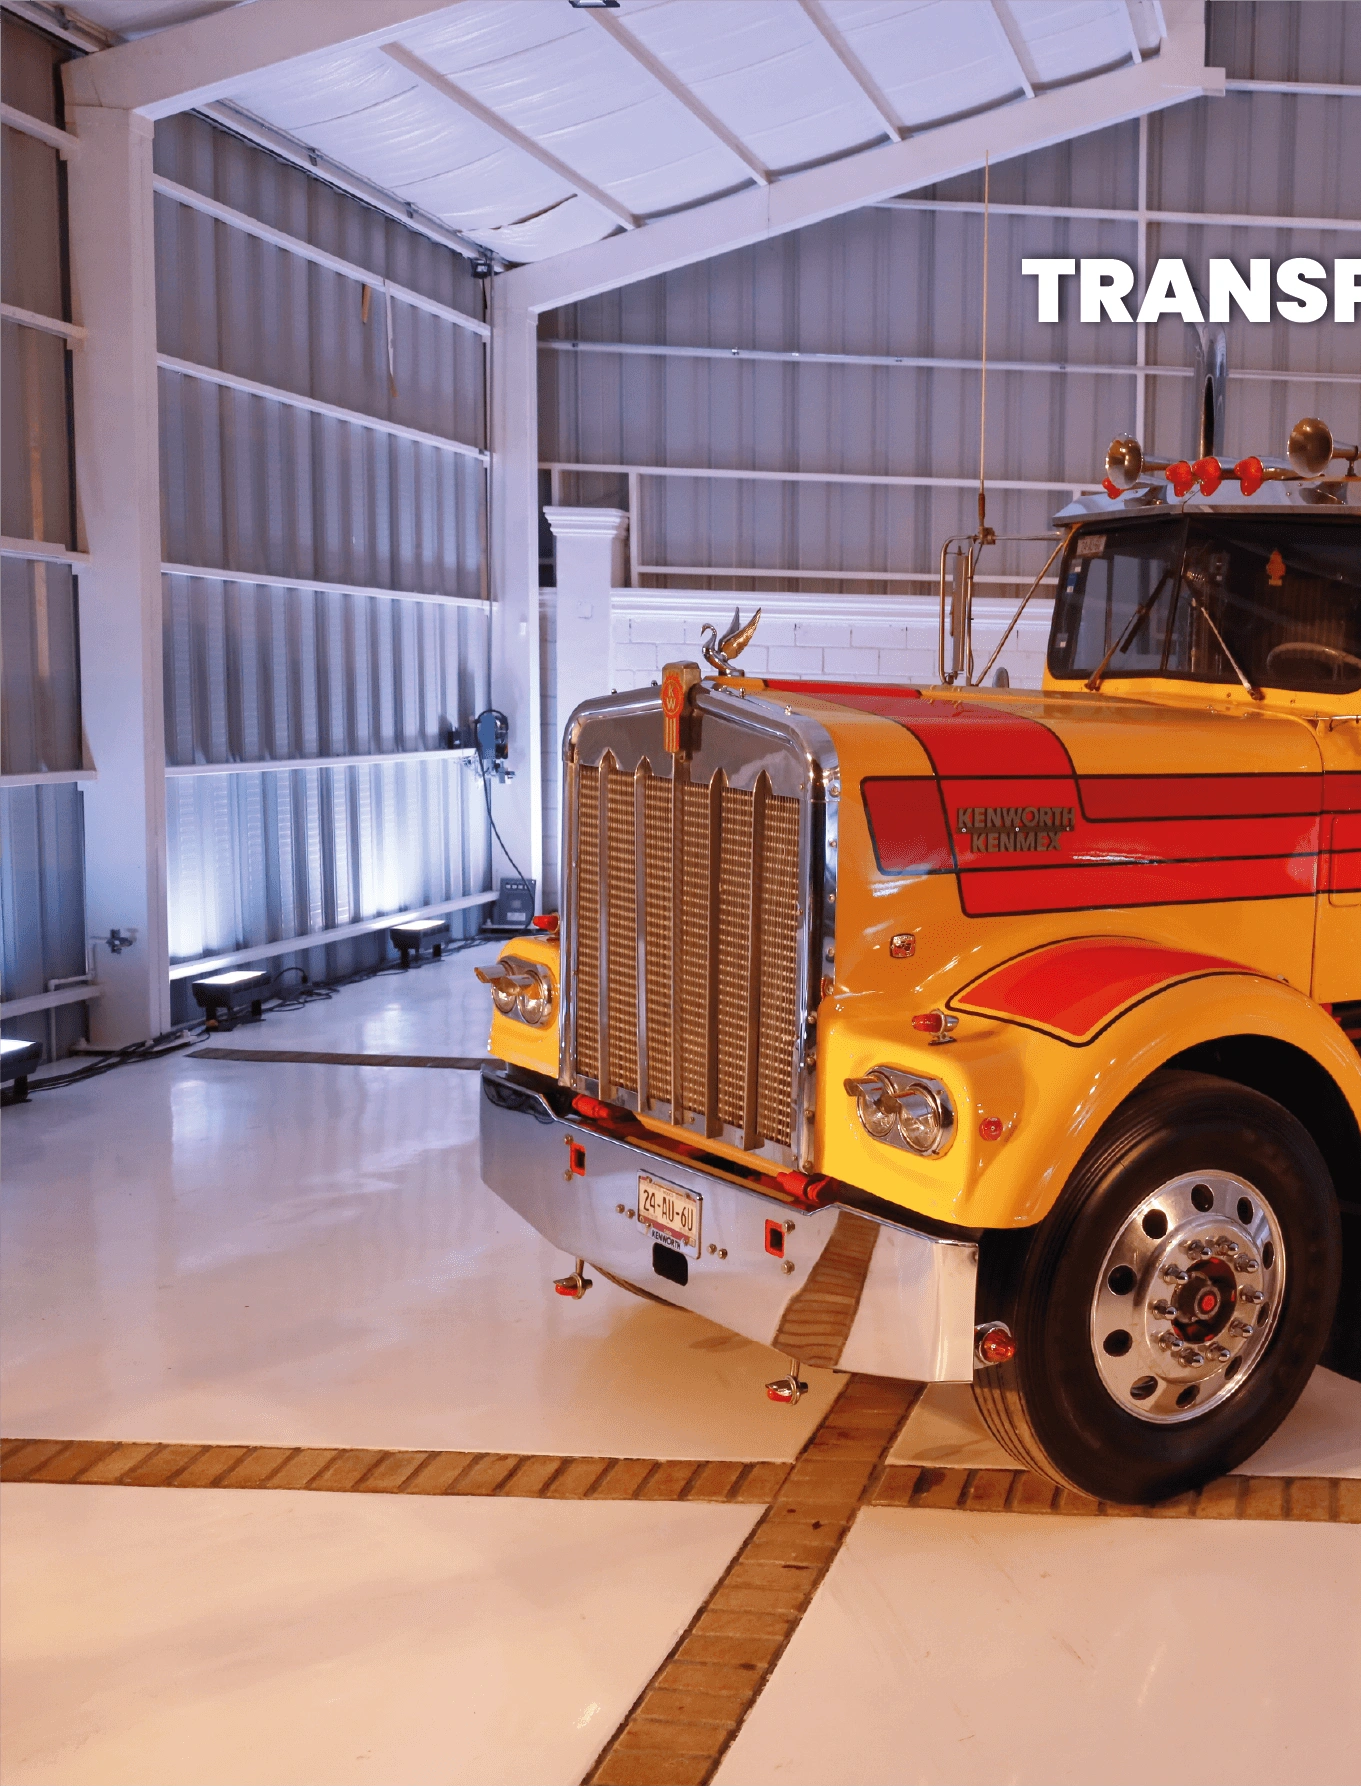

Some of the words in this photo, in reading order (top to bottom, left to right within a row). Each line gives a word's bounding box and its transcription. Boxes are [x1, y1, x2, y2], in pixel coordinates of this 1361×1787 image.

[957, 807, 1075, 828] KENWORTH
[971, 832, 1062, 852] KENMEX
[643, 1190, 693, 1231] 24-AU-6U
[652, 1231, 681, 1250] KENWORTH
